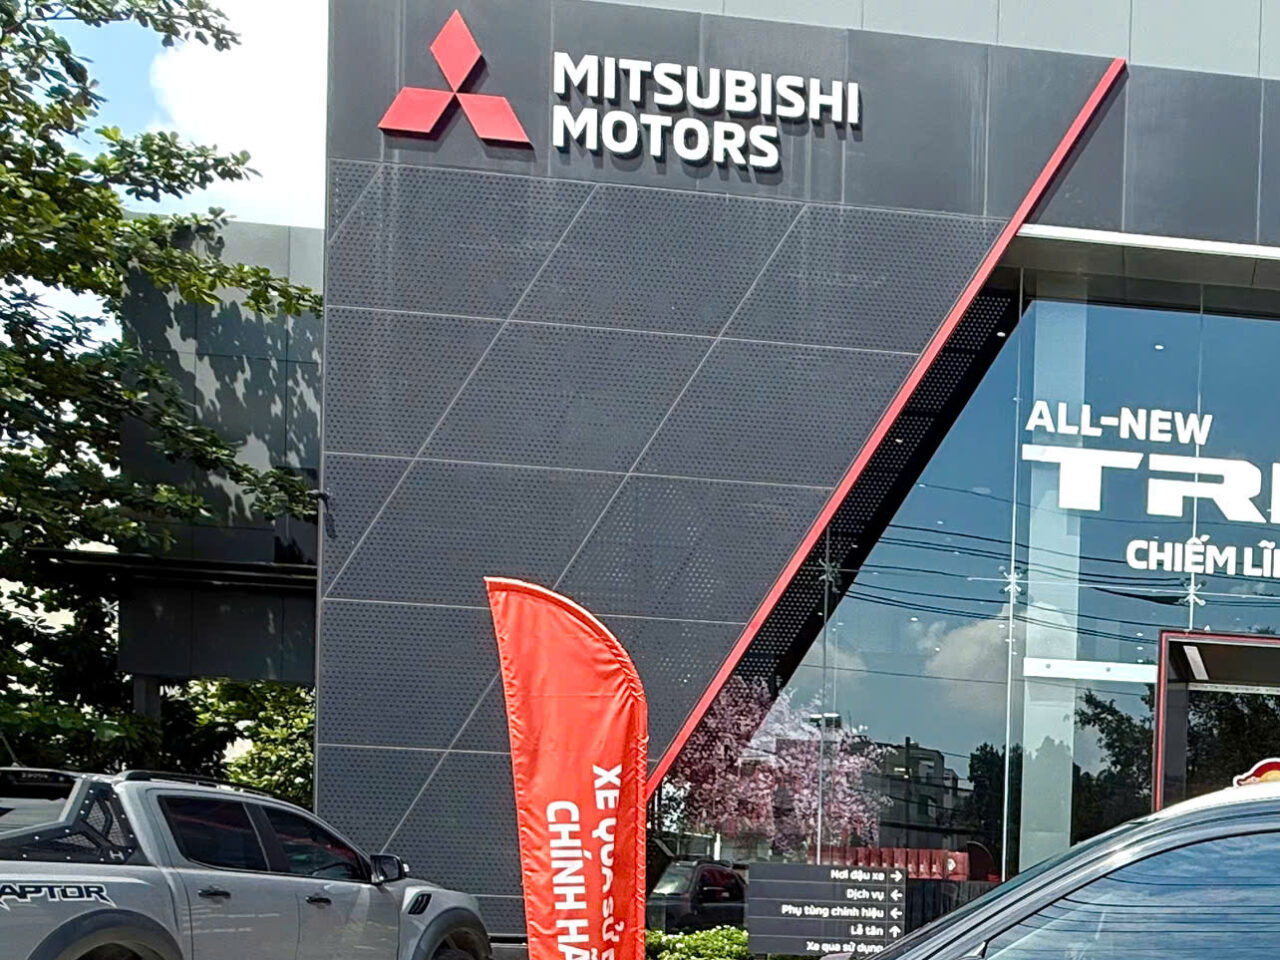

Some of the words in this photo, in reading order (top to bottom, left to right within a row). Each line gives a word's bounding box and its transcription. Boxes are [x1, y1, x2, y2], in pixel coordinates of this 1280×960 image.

[553, 51, 862, 125] MITSUBISHI
[552, 105, 781, 169] MOTORS
[1025, 400, 1212, 445] ALL-NEW
[1125, 536, 1234, 576] CHIẾM
[592, 764, 622, 810] XE
[546, 800, 592, 910] CHÍNH
[846, 888, 870, 900] Dịch
[871, 891, 884, 901] vụ
[872, 872, 885, 881] xe
[0, 883, 117, 911] APTOR
[781, 904, 802, 916] Phụ
[804, 905, 829, 917] tùng
[831, 906, 860, 916] chính
[806, 941, 820, 950] Xe
[821, 943, 841, 953] qua
